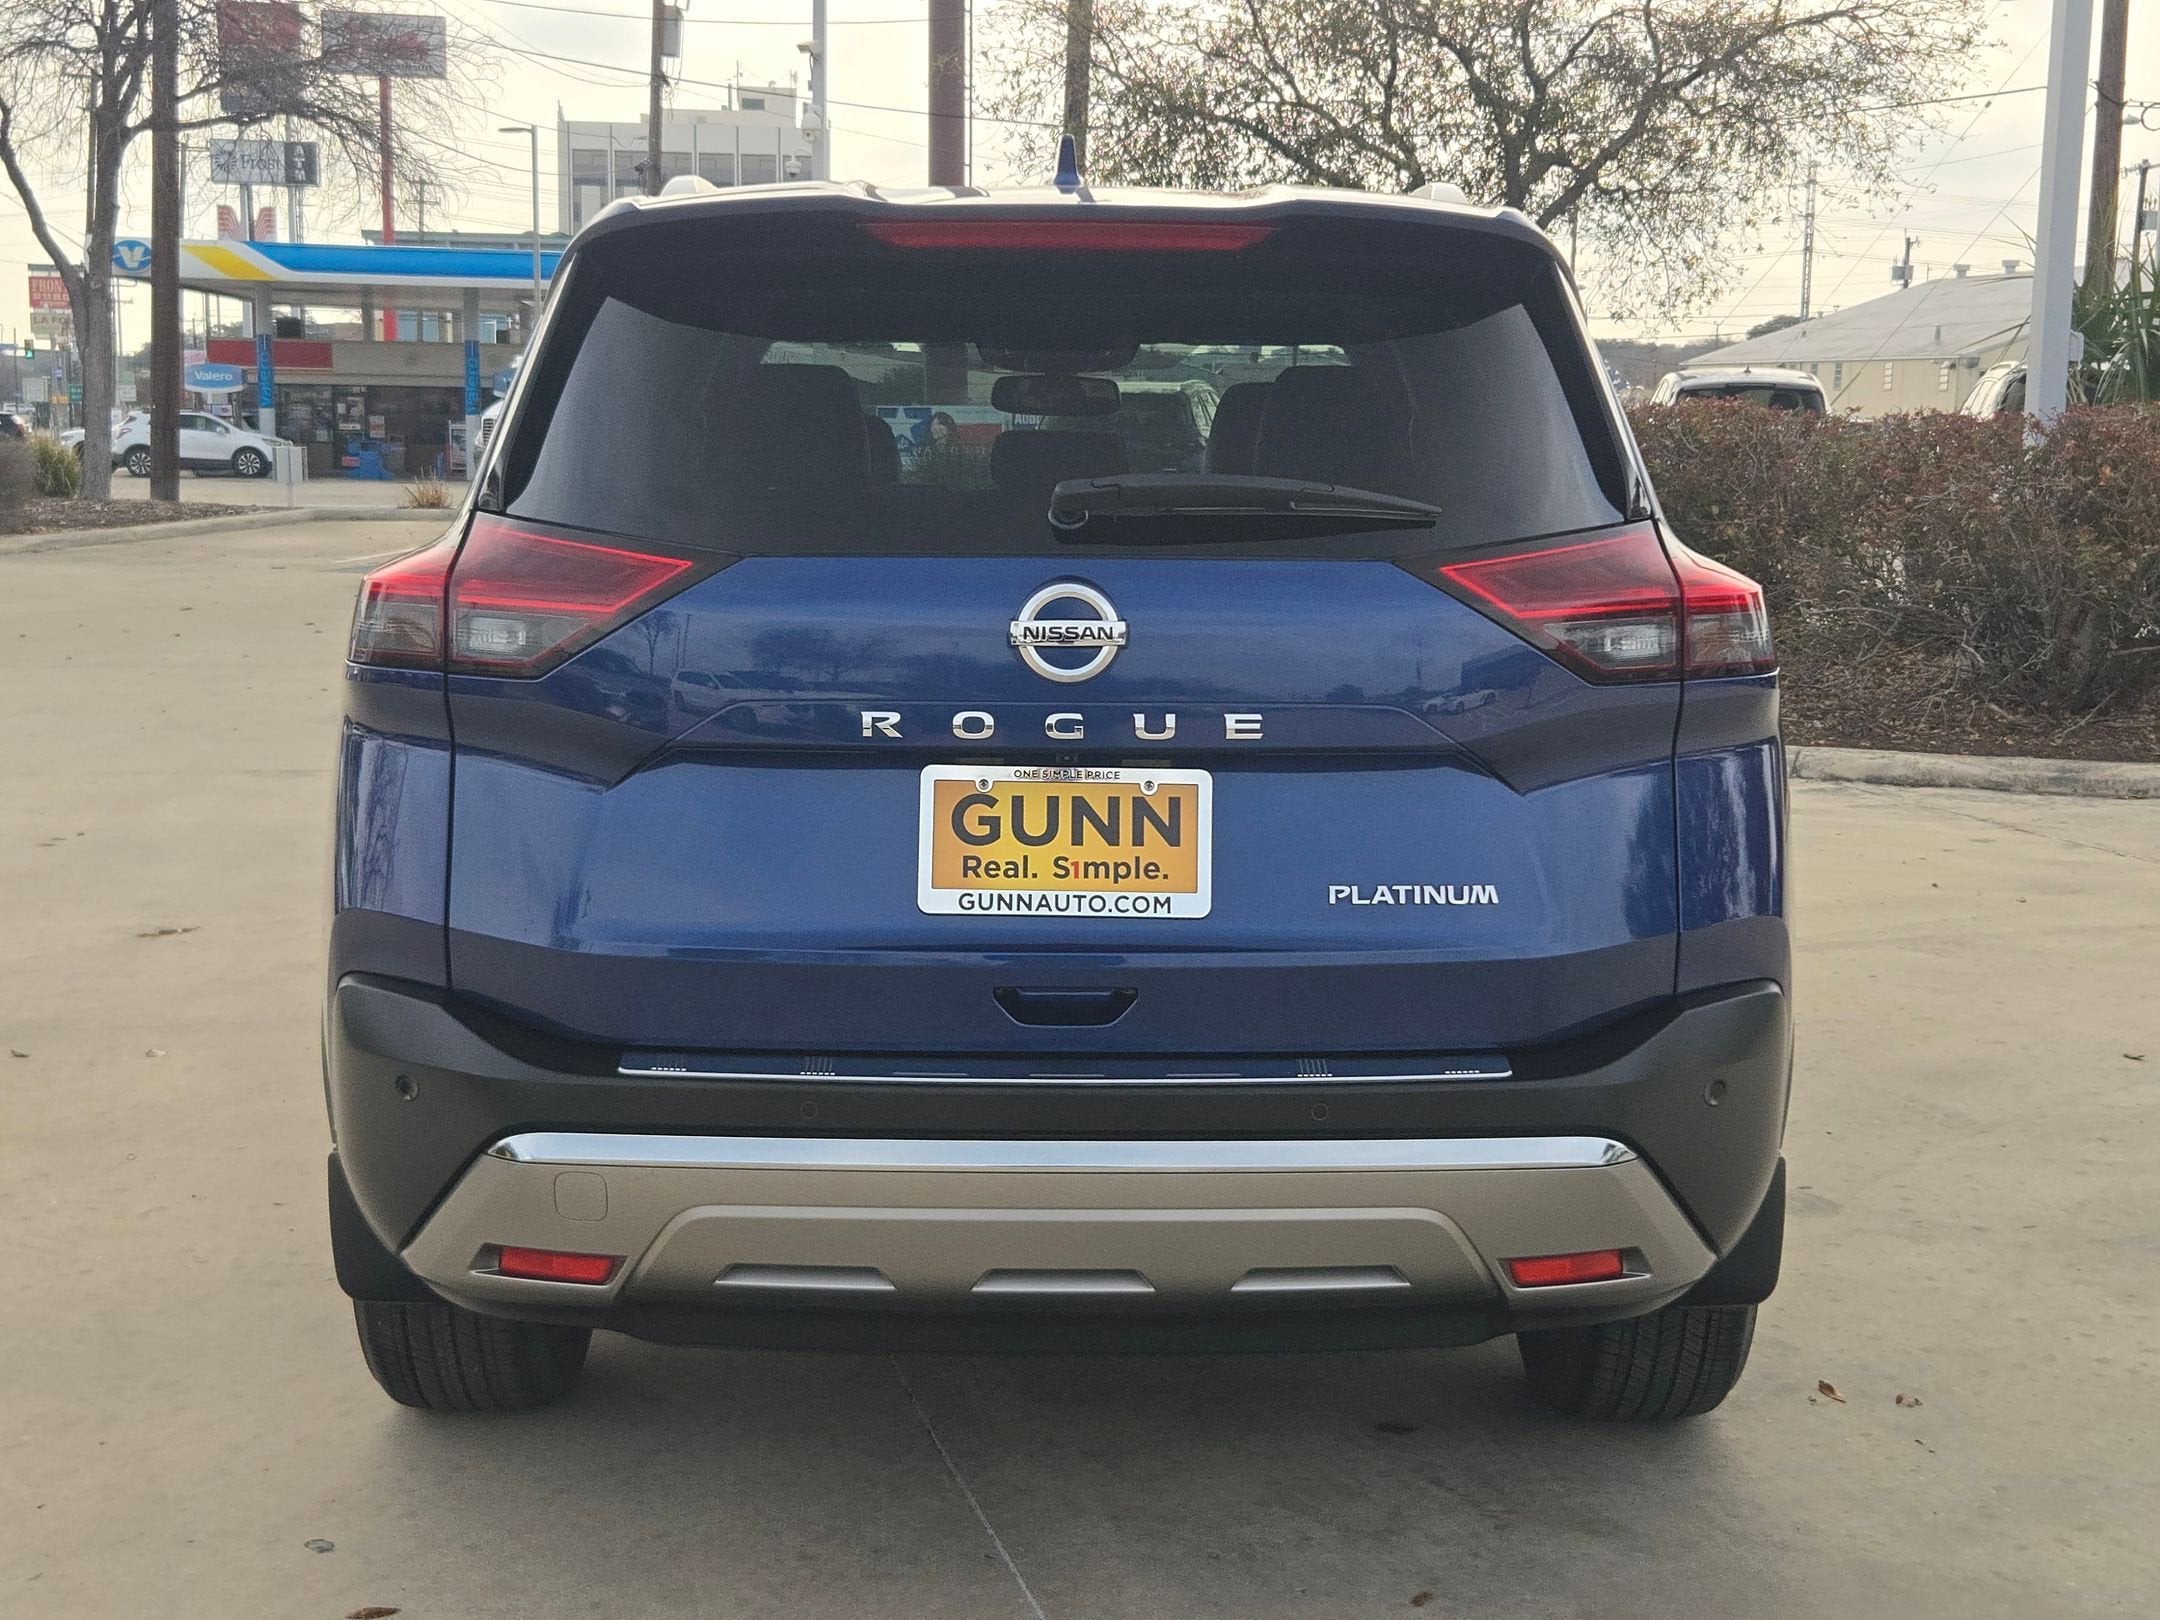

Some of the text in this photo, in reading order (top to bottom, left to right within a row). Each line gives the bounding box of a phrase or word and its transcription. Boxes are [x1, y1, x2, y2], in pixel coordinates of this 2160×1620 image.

[194, 370, 233, 381] Valero
[1022, 625, 1115, 642] NISSAN
[860, 710, 1264, 741] ROGUE
[1013, 769, 1121, 780] ONE SIMPLE PRICE
[950, 793, 1181, 848] GUNN
[962, 855, 1038, 879] Real.
[958, 893, 1172, 914] GUNNAUTO.COM
[1329, 885, 1499, 905] PLATINUM
